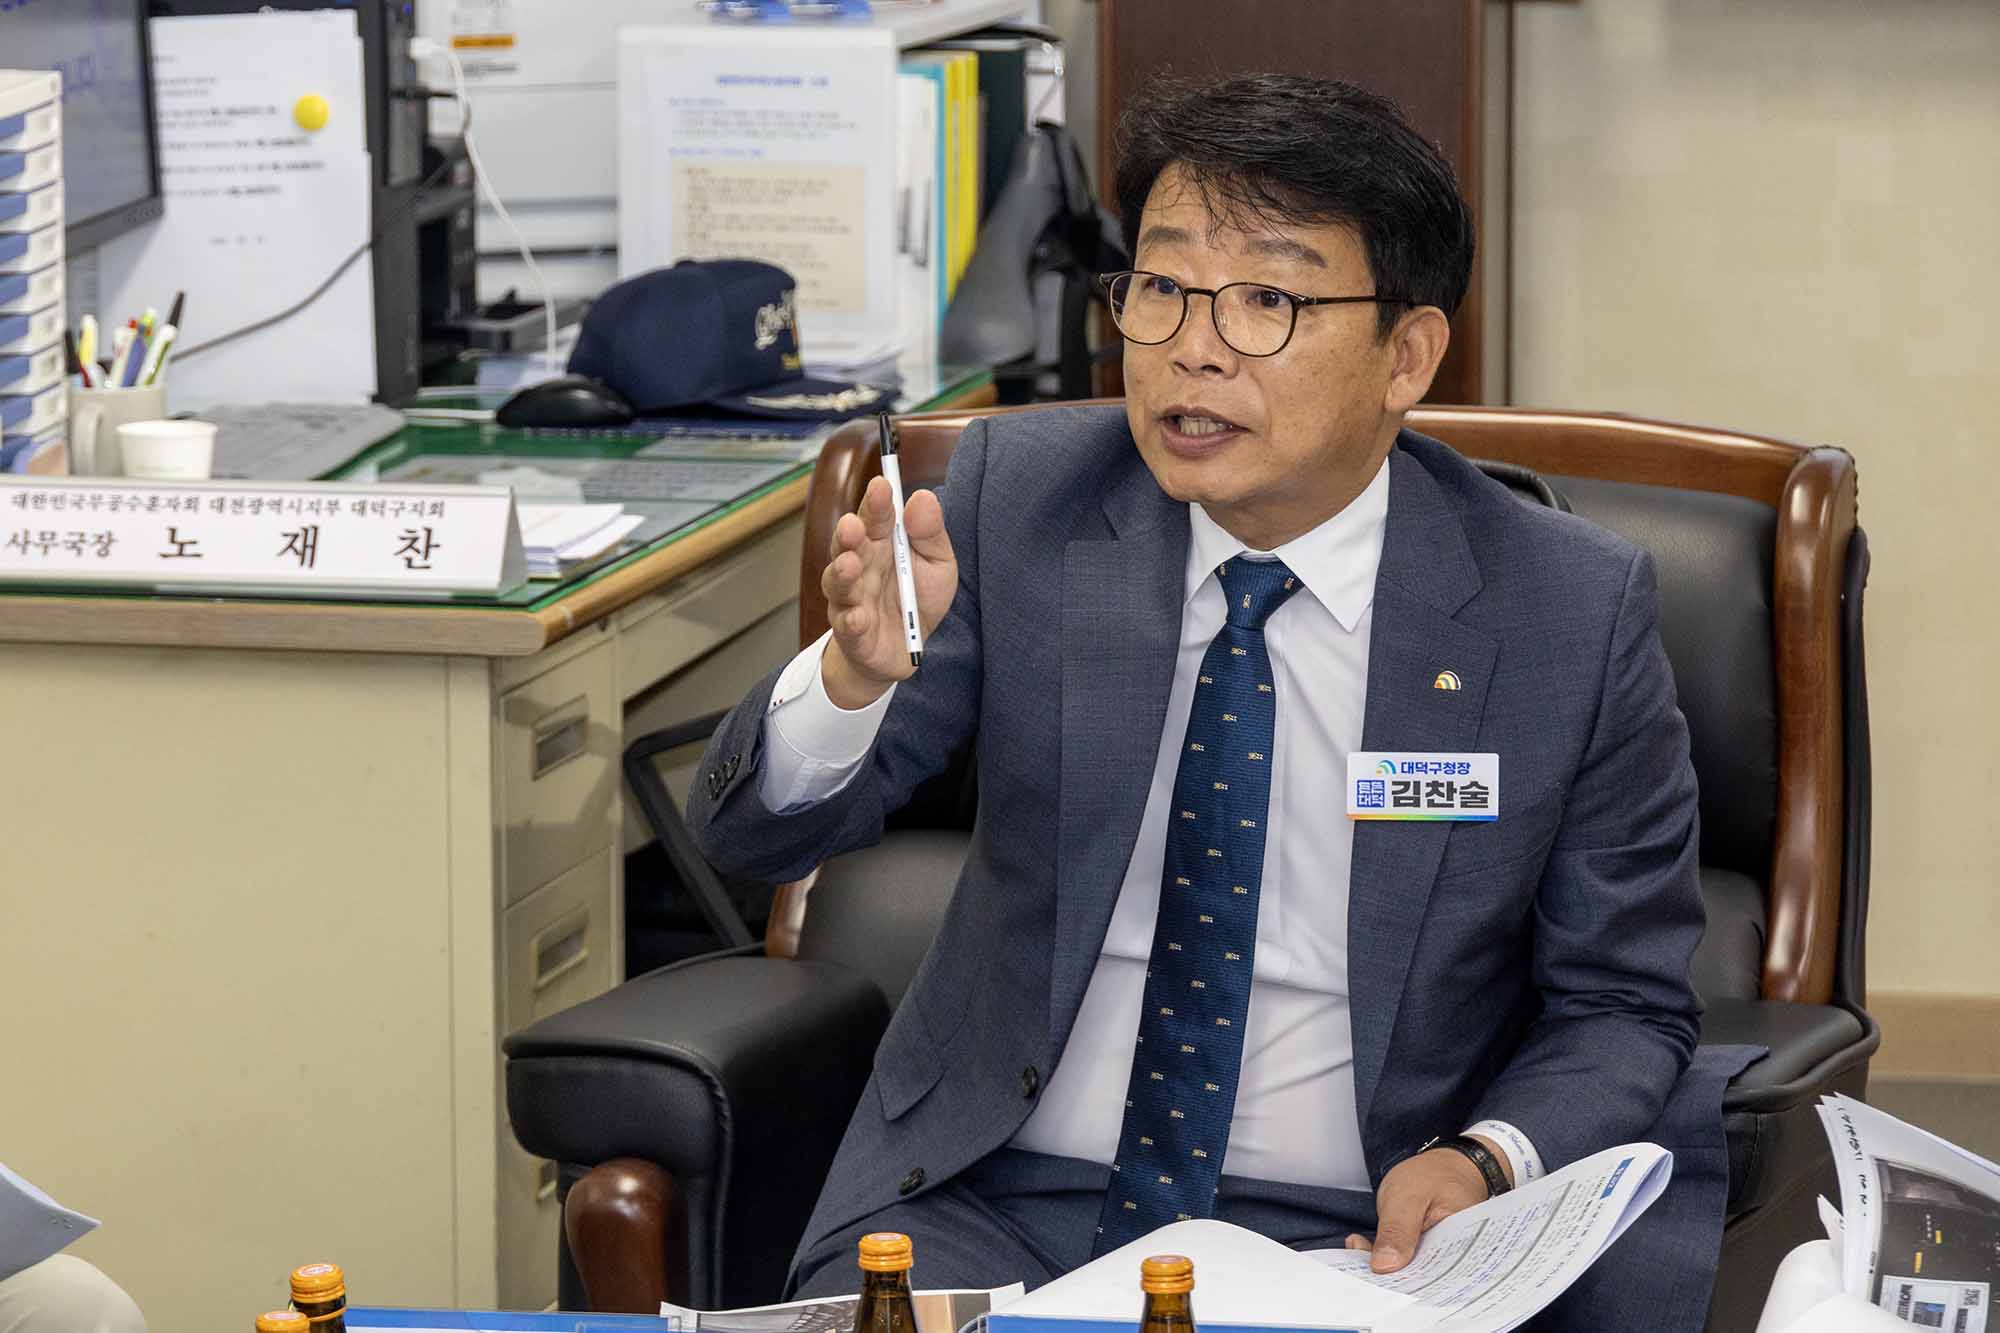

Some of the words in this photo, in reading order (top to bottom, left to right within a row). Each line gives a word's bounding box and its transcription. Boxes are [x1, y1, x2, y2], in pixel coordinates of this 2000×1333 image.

[350, 499, 446, 519] 대덕구지회
[5, 528, 118, 557] 사무국장
[159, 527, 203, 558] 노
[276, 524, 319, 568] 재
[393, 526, 440, 569] 찬
[1400, 761, 1471, 775] 대덕구청장
[1391, 780, 1489, 808] 김찬술
